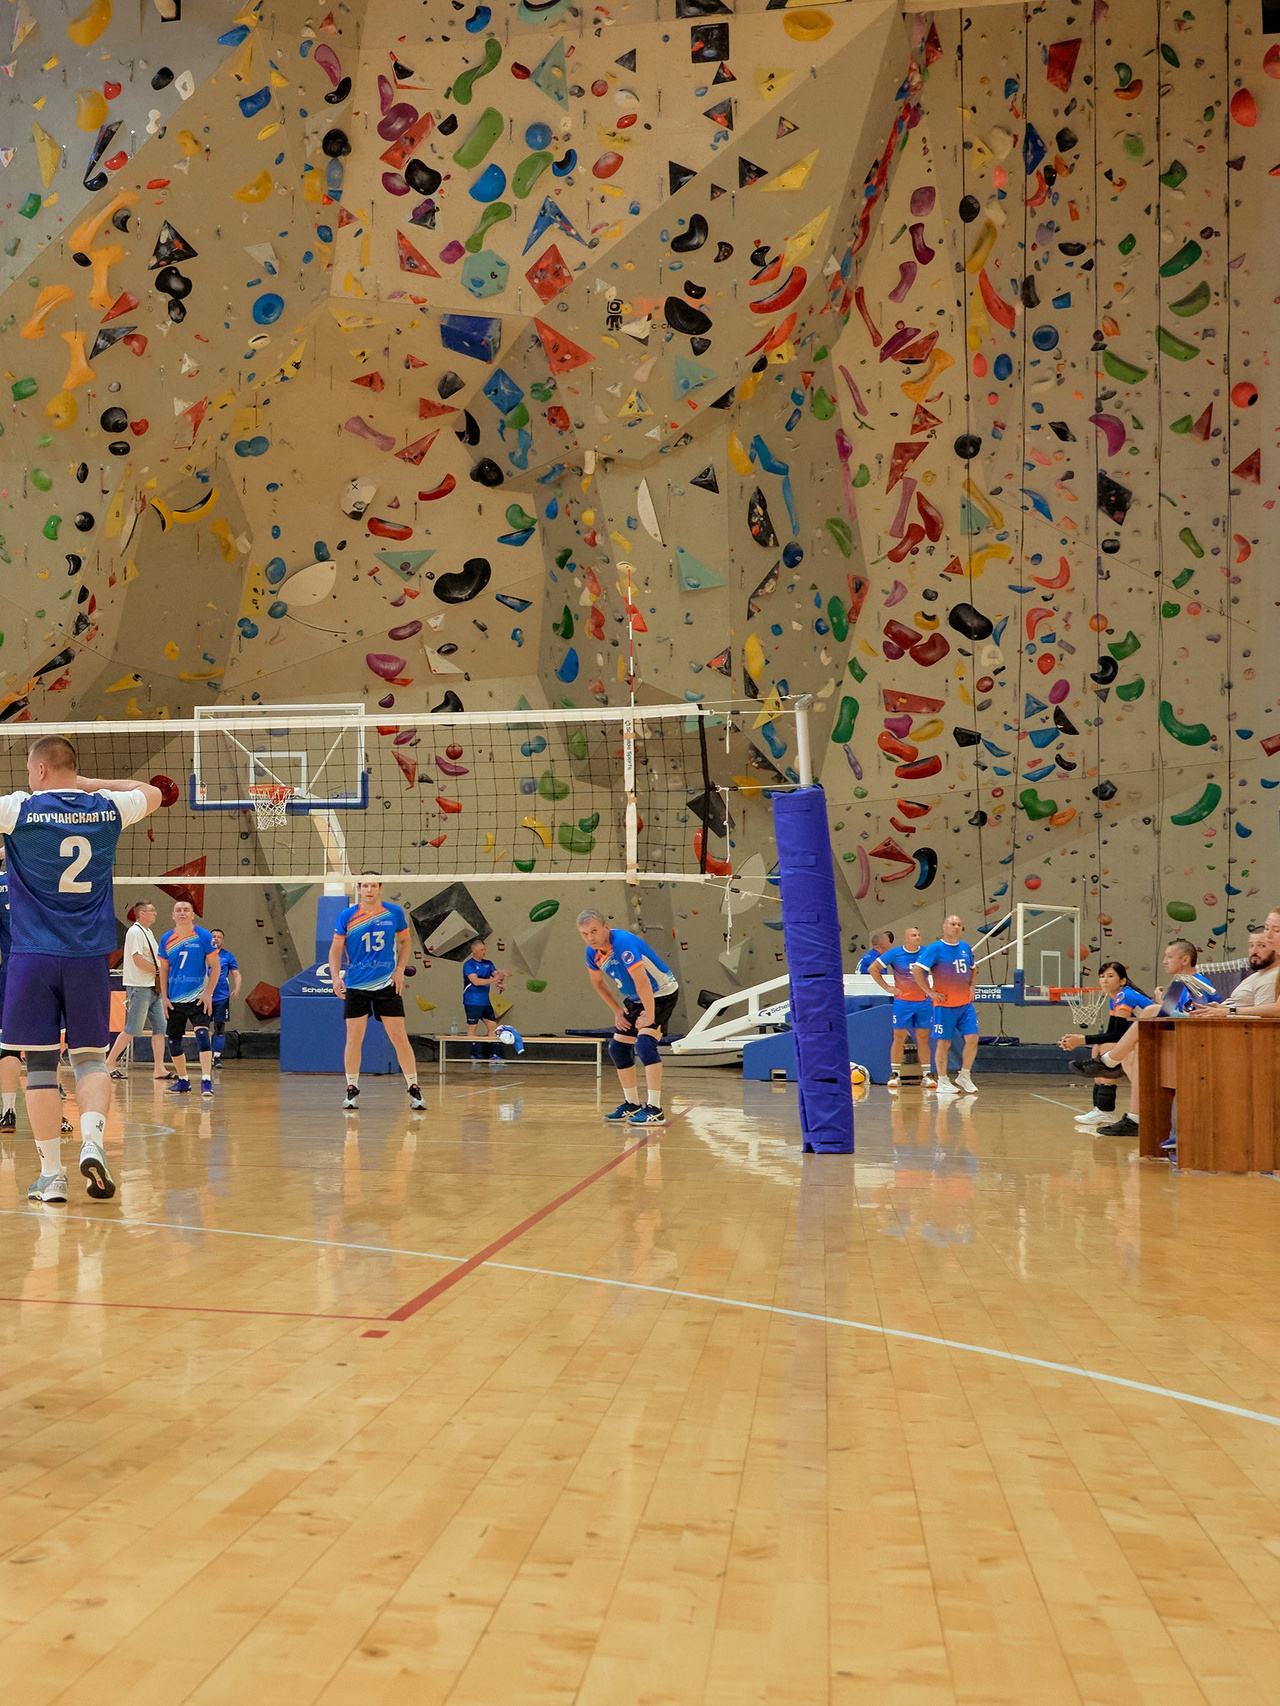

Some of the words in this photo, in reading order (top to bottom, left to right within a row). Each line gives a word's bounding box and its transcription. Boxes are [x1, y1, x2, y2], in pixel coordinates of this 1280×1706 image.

[26, 812, 100, 824] БОГУЧАНСКАЯ
[58, 835, 92, 893] 2
[361, 930, 385, 952] 13
[179, 951, 189, 969] 7
[952, 958, 968, 974] 15
